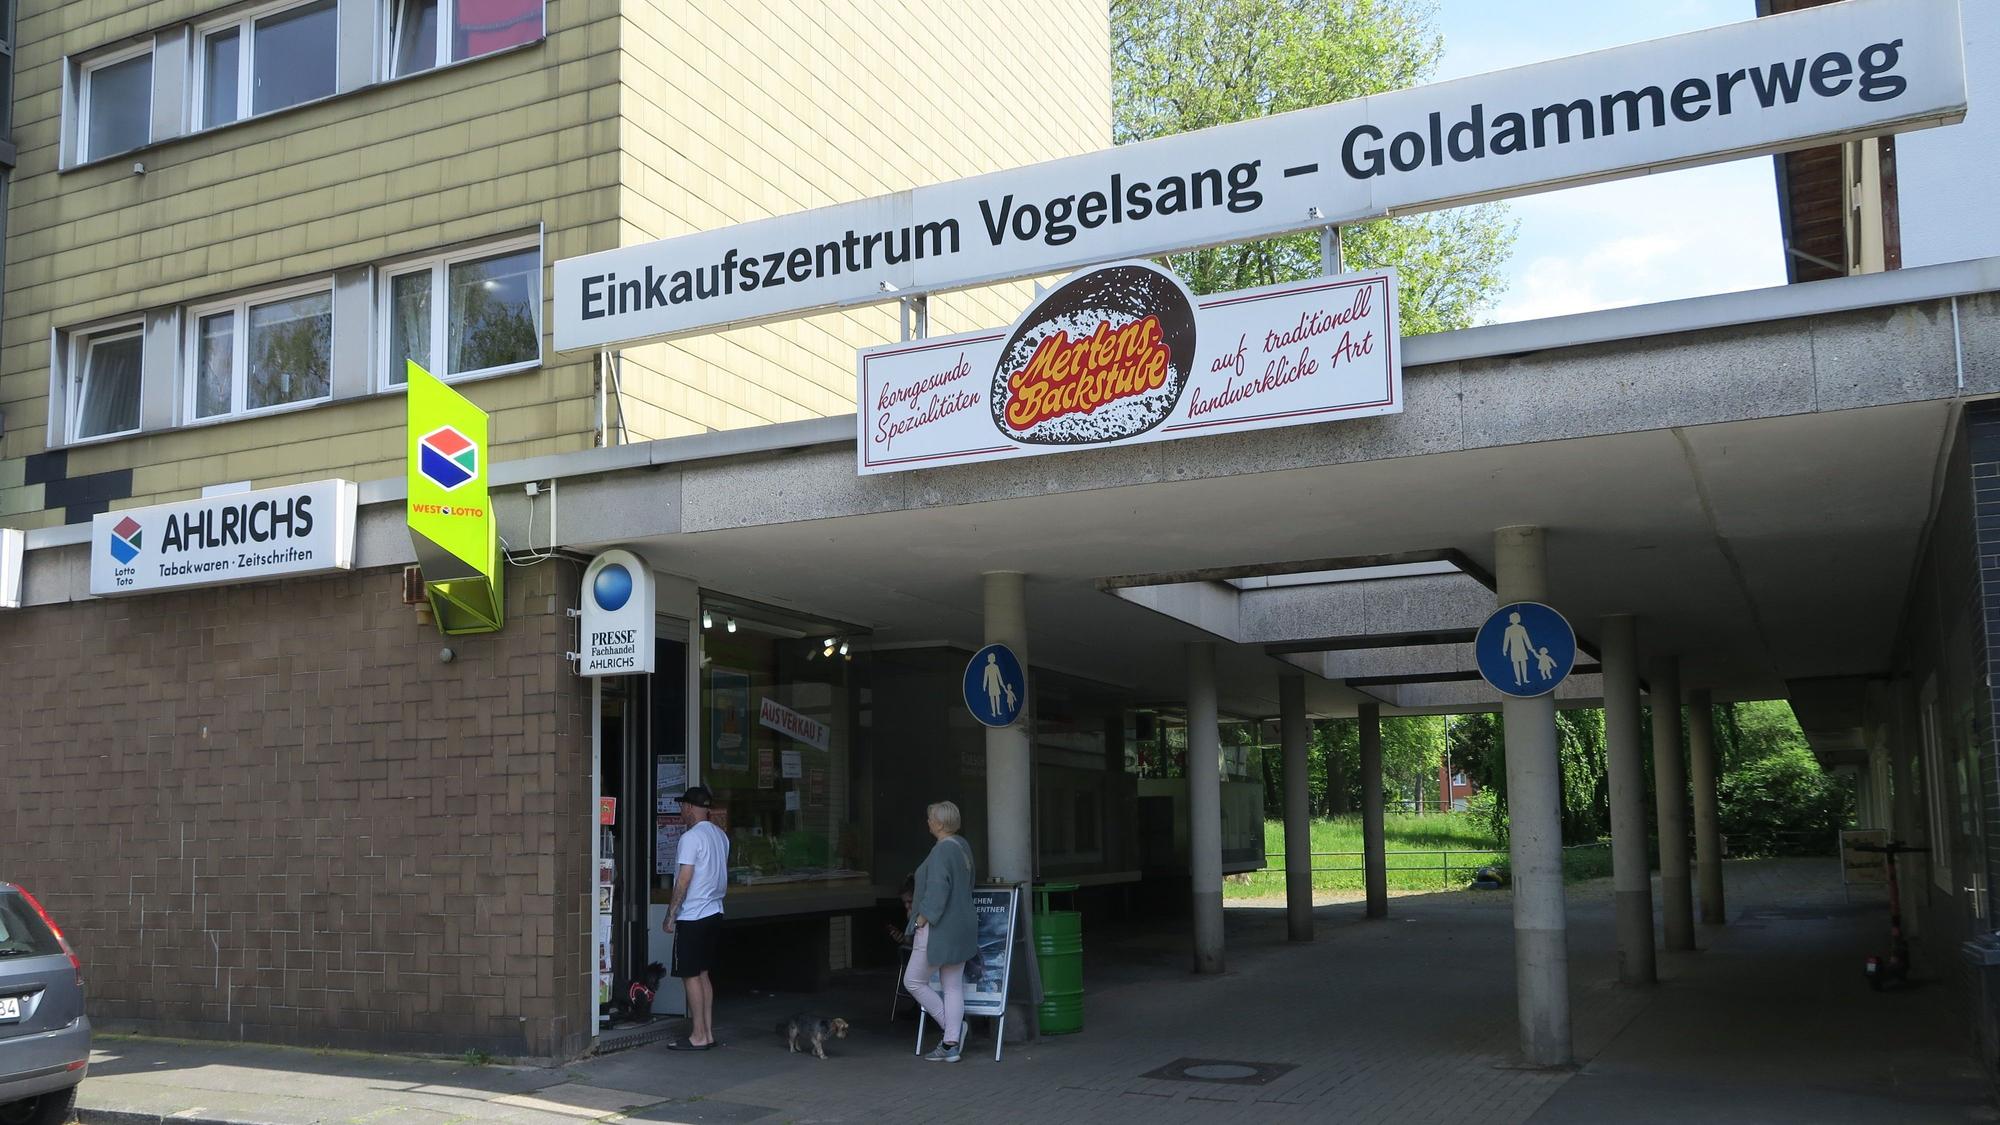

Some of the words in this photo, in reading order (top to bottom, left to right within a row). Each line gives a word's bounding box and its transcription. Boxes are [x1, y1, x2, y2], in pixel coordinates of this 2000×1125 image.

[581, 217, 960, 321] Einkaufszentrum
[978, 159, 1263, 247] Vogelsang
[1341, 38, 1908, 180] Goldammerweg
[1211, 334, 1248, 376] auf
[1263, 285, 1373, 353] traditionell
[877, 352, 972, 411] korngesunde
[1188, 346, 1319, 419] handwerkliche
[1331, 330, 1373, 369] Art
[875, 391, 981, 451] Spezialitäten
[161, 495, 314, 554] AHLRICHS
[115, 567, 136, 577] Lotto
[116, 577, 134, 587] Toto
[159, 558, 229, 577] Tabakwaren
[238, 547, 313, 568] Zeitschriften
[592, 630, 635, 647] PRESSE
[592, 645, 635, 656] Fachhandel
[590, 657, 634, 669] AHLRICHS
